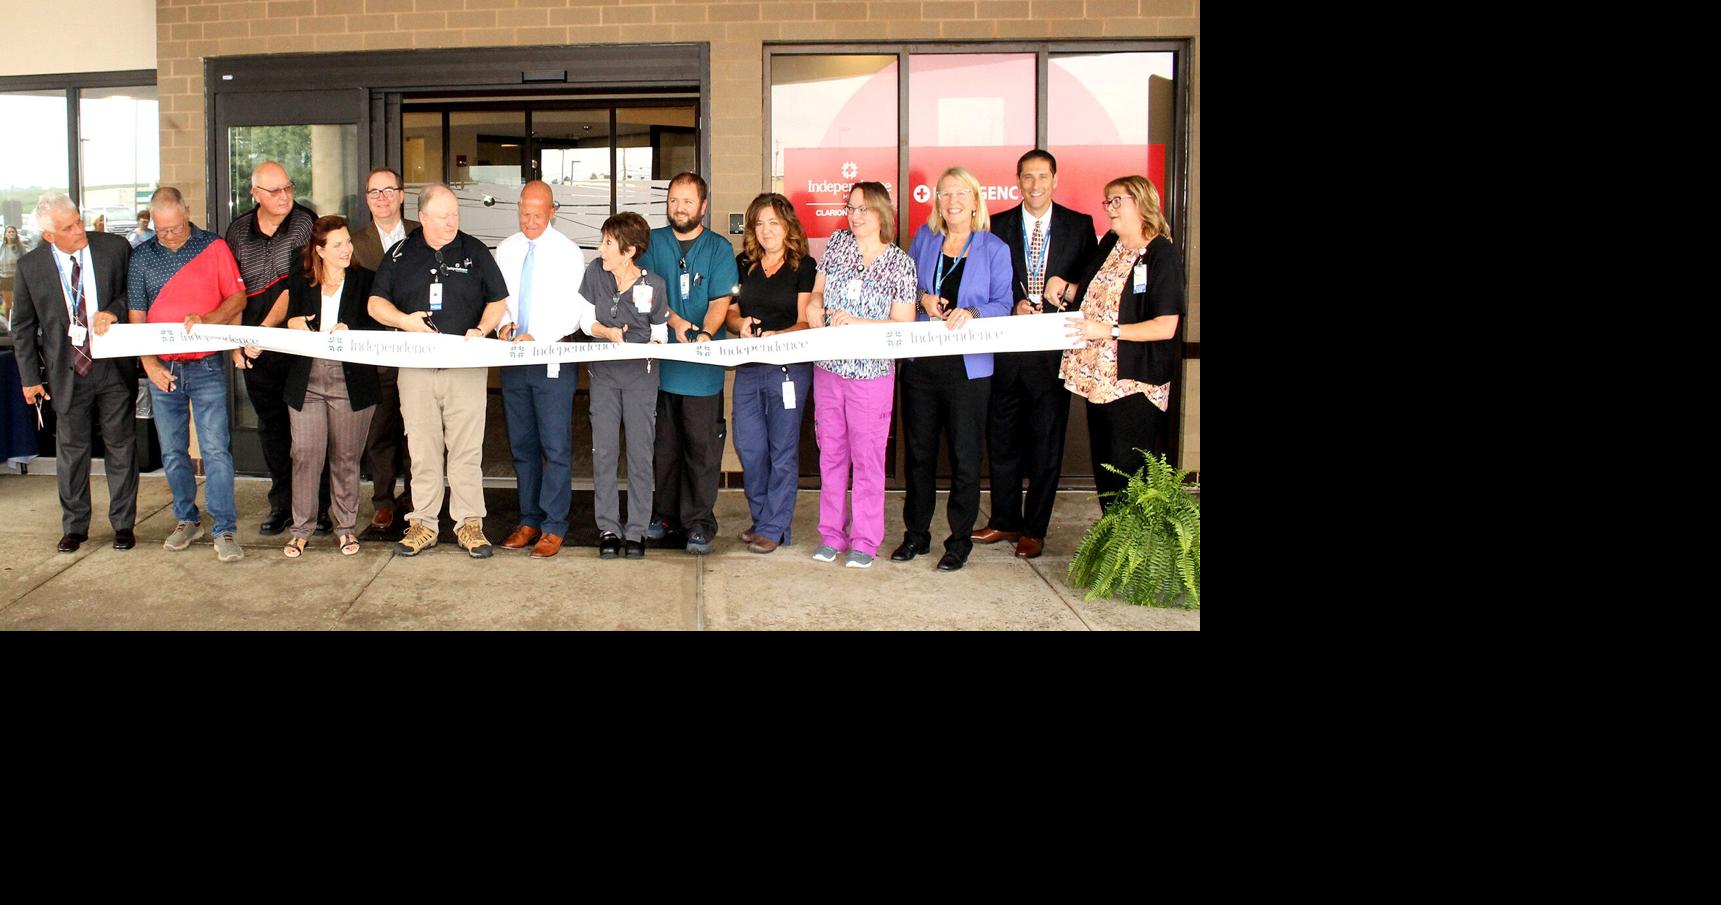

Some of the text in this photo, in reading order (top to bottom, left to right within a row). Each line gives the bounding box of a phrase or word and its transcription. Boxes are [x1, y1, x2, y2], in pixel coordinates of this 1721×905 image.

[815, 208, 848, 216] CLARION
[911, 328, 1004, 345] Independence
[350, 339, 436, 355] Independence
[719, 340, 809, 356] Independence
